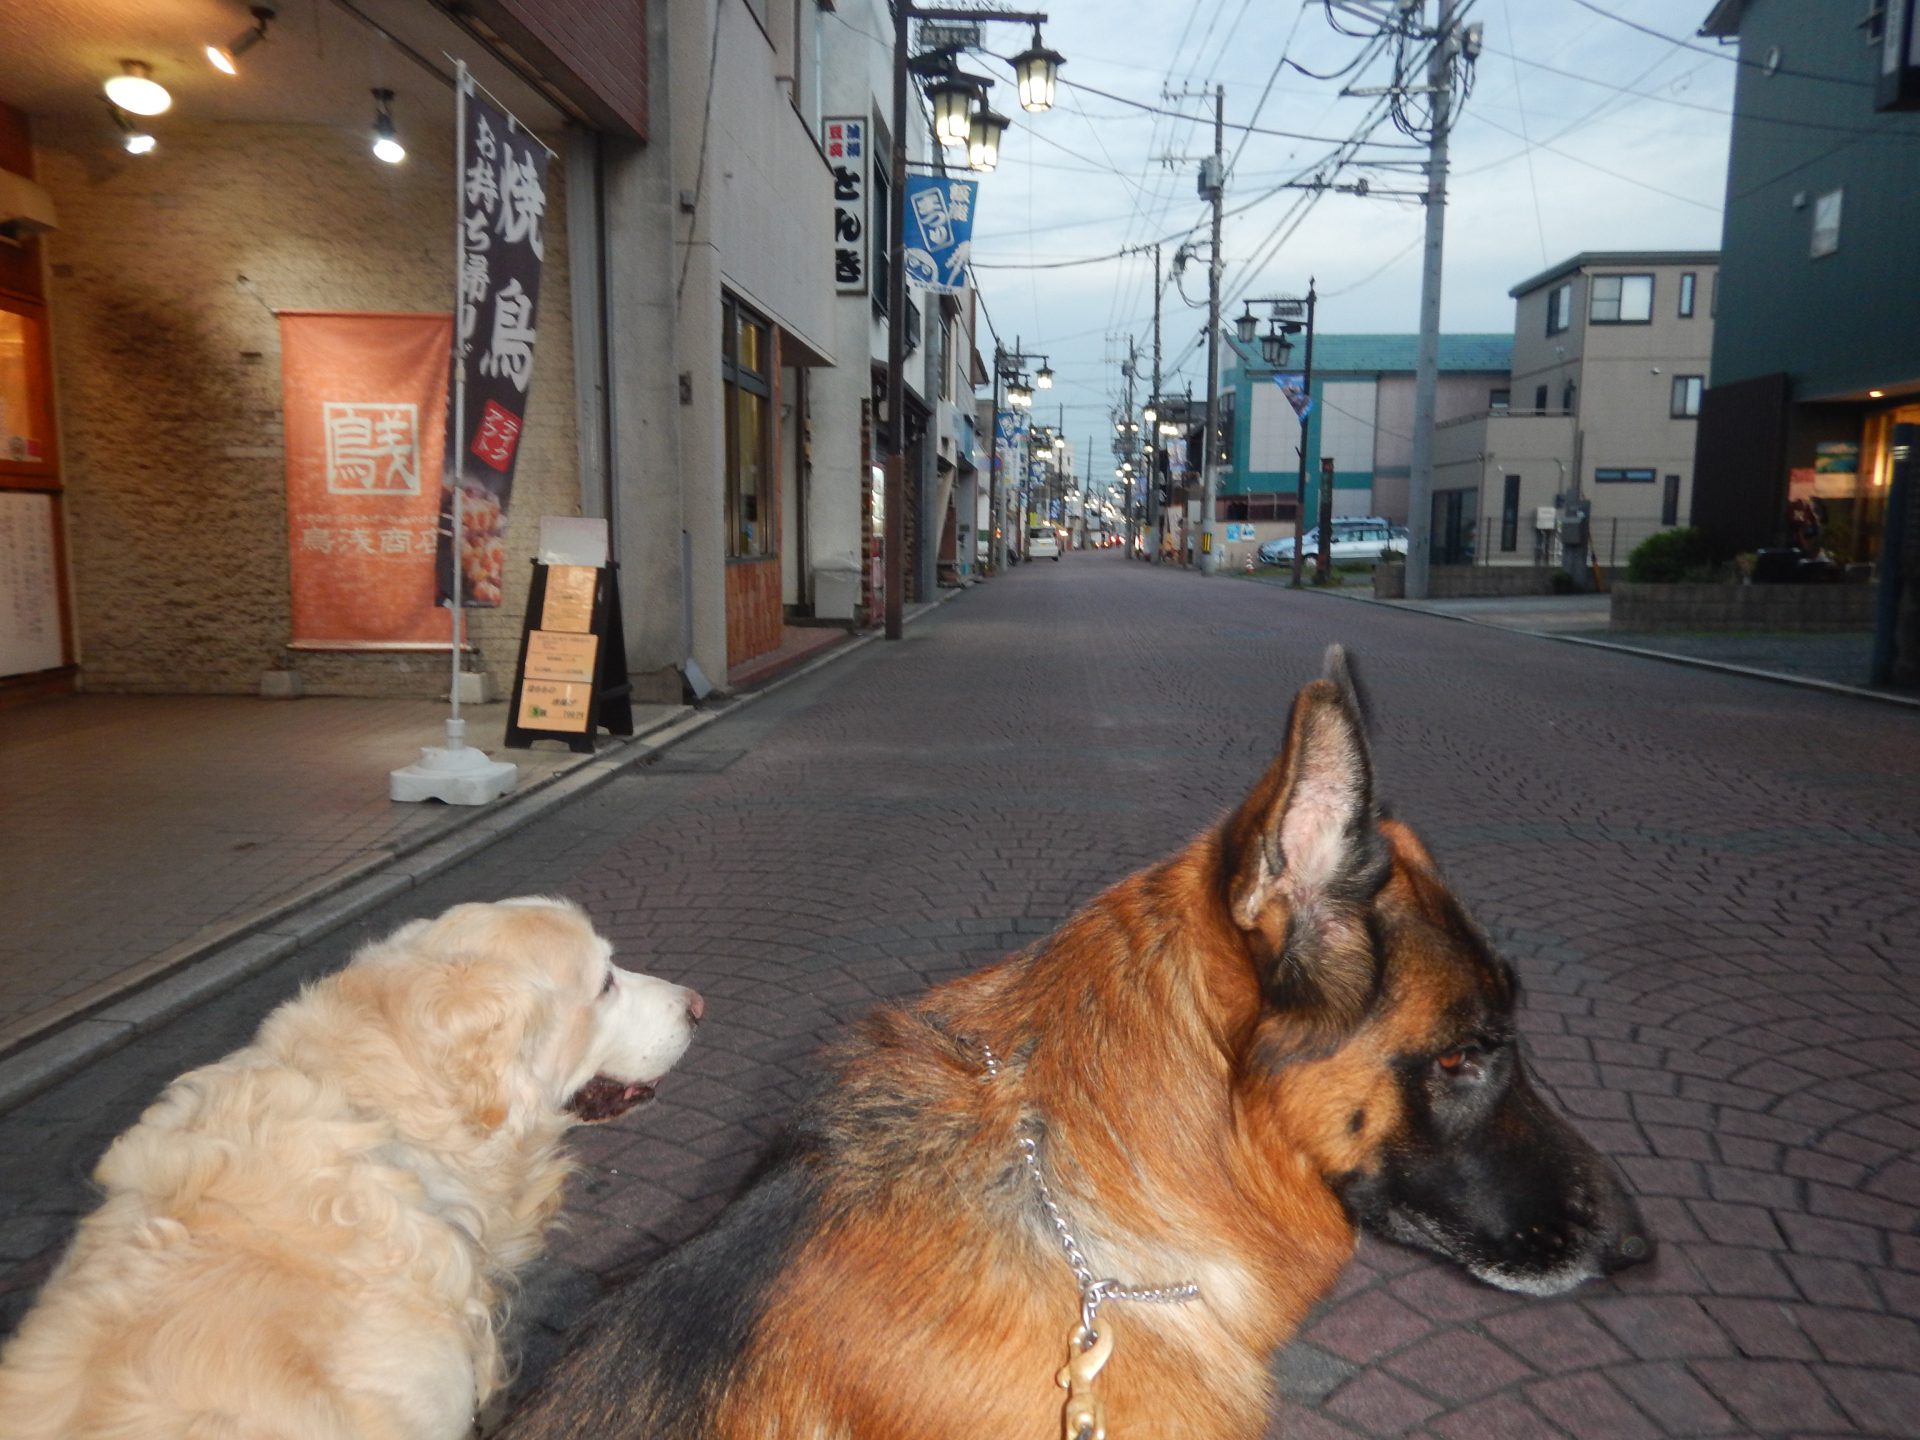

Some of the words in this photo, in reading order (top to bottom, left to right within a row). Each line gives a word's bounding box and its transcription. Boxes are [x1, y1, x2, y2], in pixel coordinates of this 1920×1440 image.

[479, 141, 547, 393] 焼鳥
[916, 193, 949, 245] まつり
